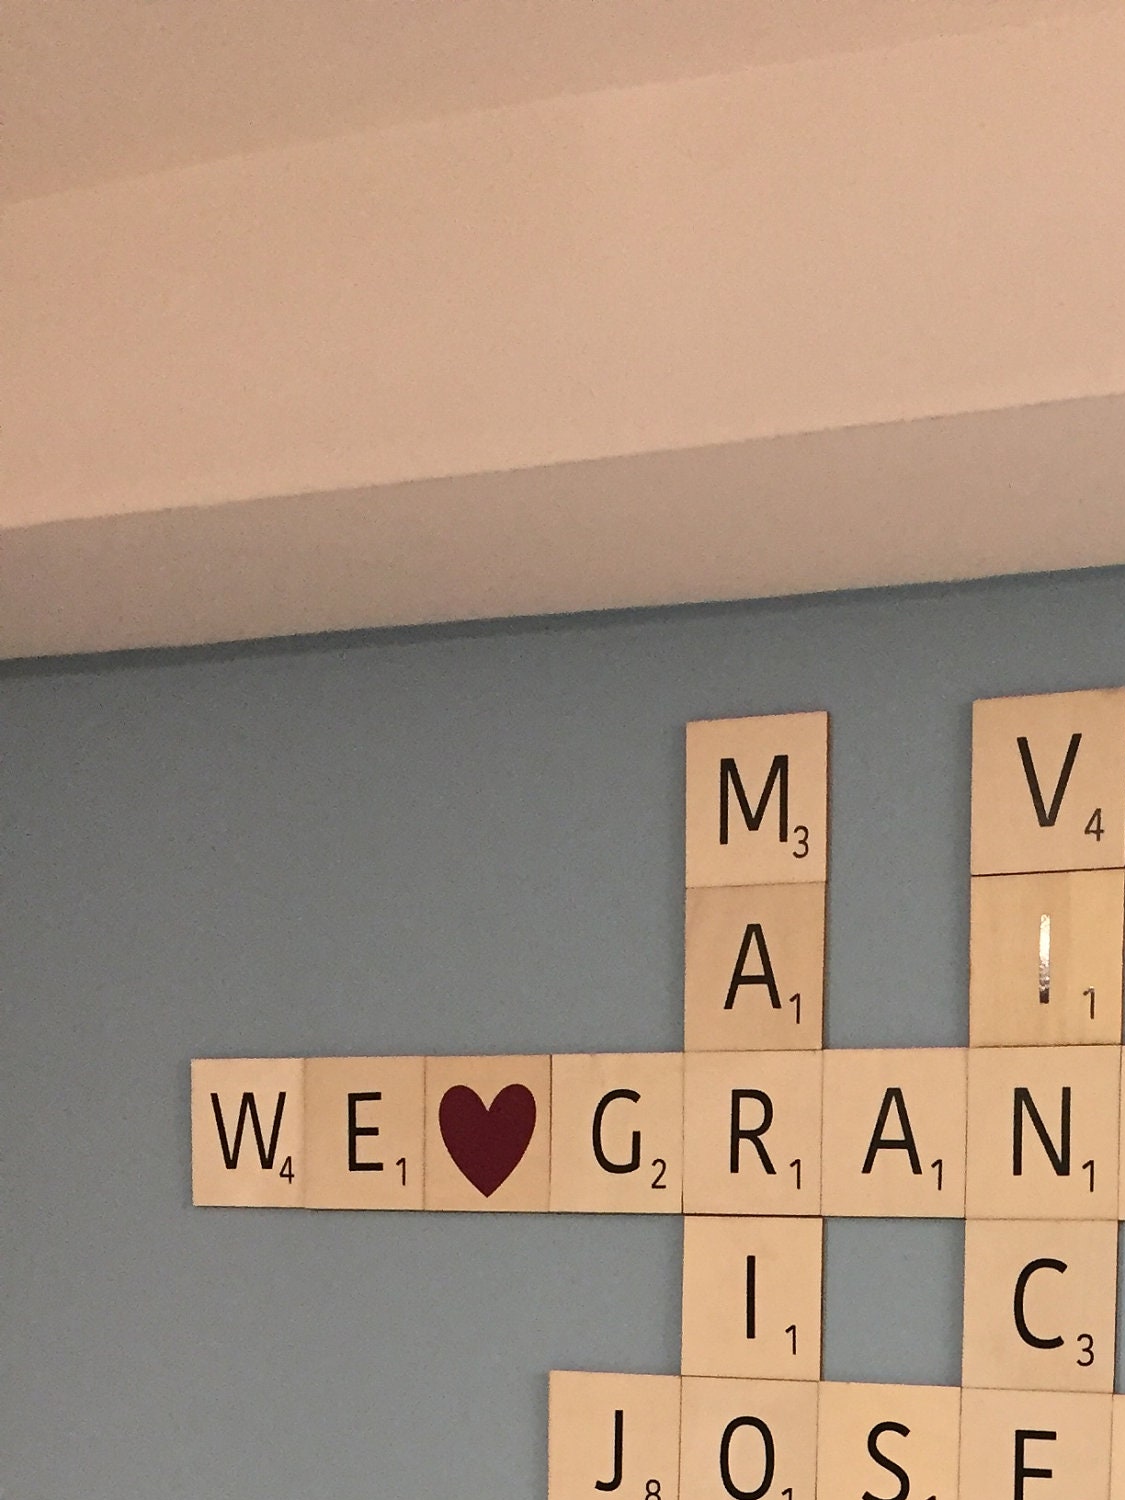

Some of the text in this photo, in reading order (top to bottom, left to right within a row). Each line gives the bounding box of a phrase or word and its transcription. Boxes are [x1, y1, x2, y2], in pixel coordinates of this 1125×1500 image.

[791, 824, 810, 860] 3
[1083, 806, 1106, 843] 4
[788, 991, 802, 1026] 1
[1081, 987, 1096, 1021] 1
[209, 1090, 385, 1174] WE
[277, 1154, 296, 1186] 4
[394, 1156, 408, 1188] 1
[650, 1157, 668, 1191] 2
[788, 1157, 802, 1191] 1
[929, 1157, 944, 1192] 1
[1080, 1158, 1096, 1194] 1
[784, 1323, 798, 1357] 1
[1075, 1332, 1096, 1368] 3
